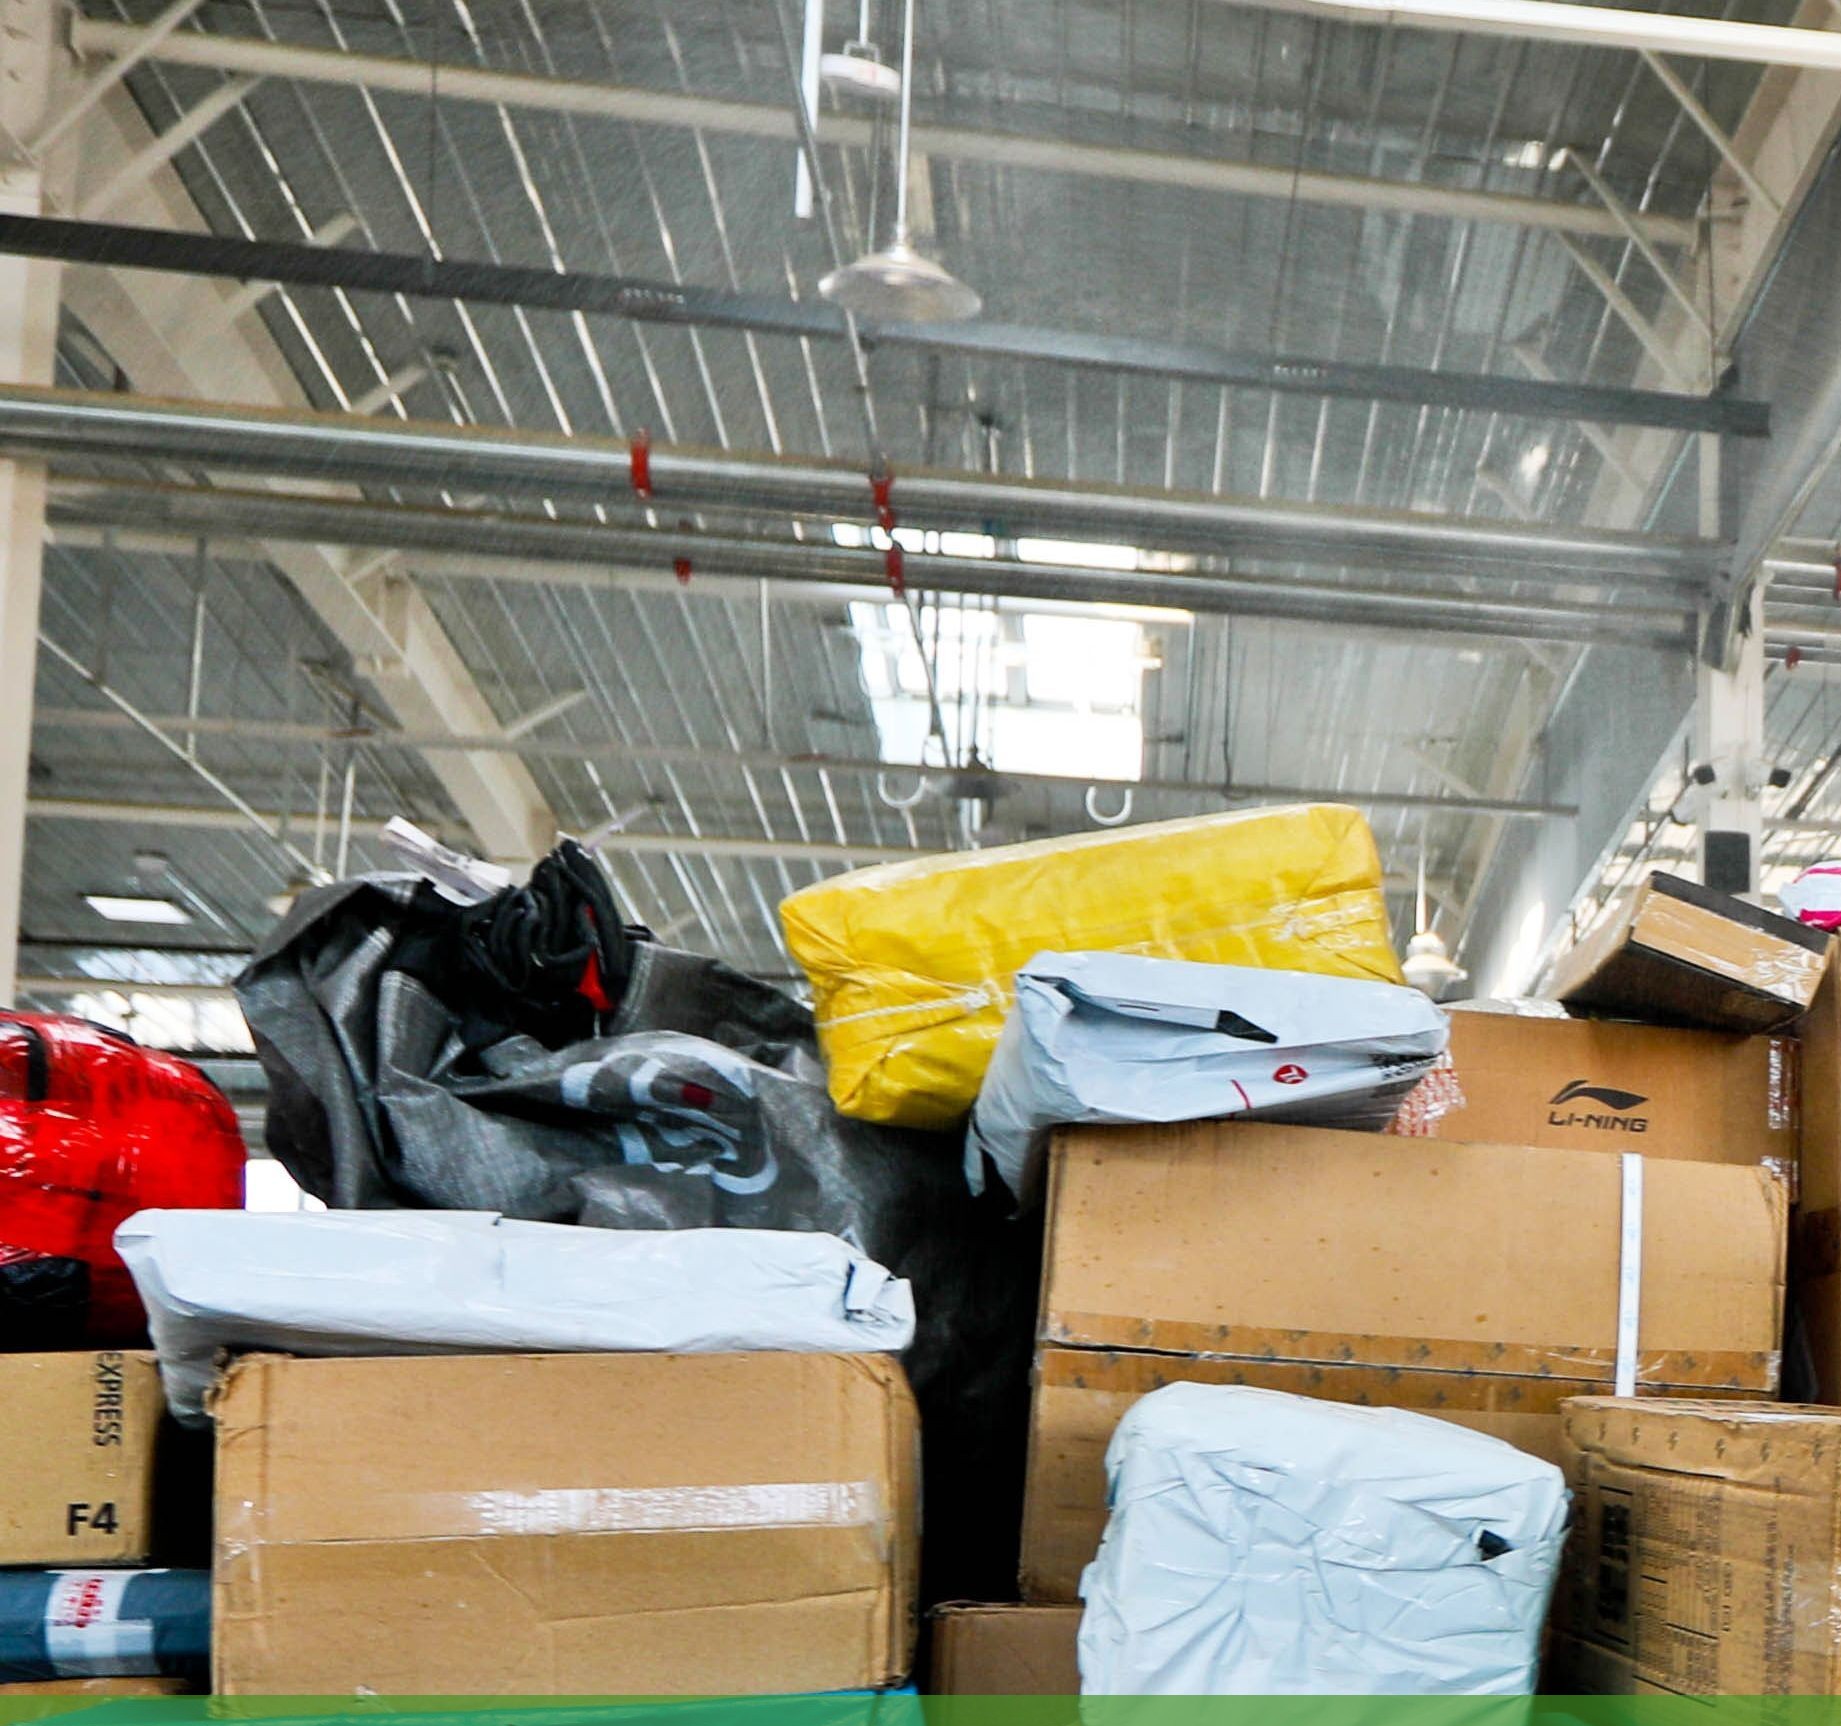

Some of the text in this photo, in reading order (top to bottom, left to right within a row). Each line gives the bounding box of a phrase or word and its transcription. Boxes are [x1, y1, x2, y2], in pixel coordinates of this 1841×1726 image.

[1547, 1111, 1649, 1133] LI-NING
[93, 1350, 124, 1447] EXPRESS
[66, 1501, 119, 1536] F4
